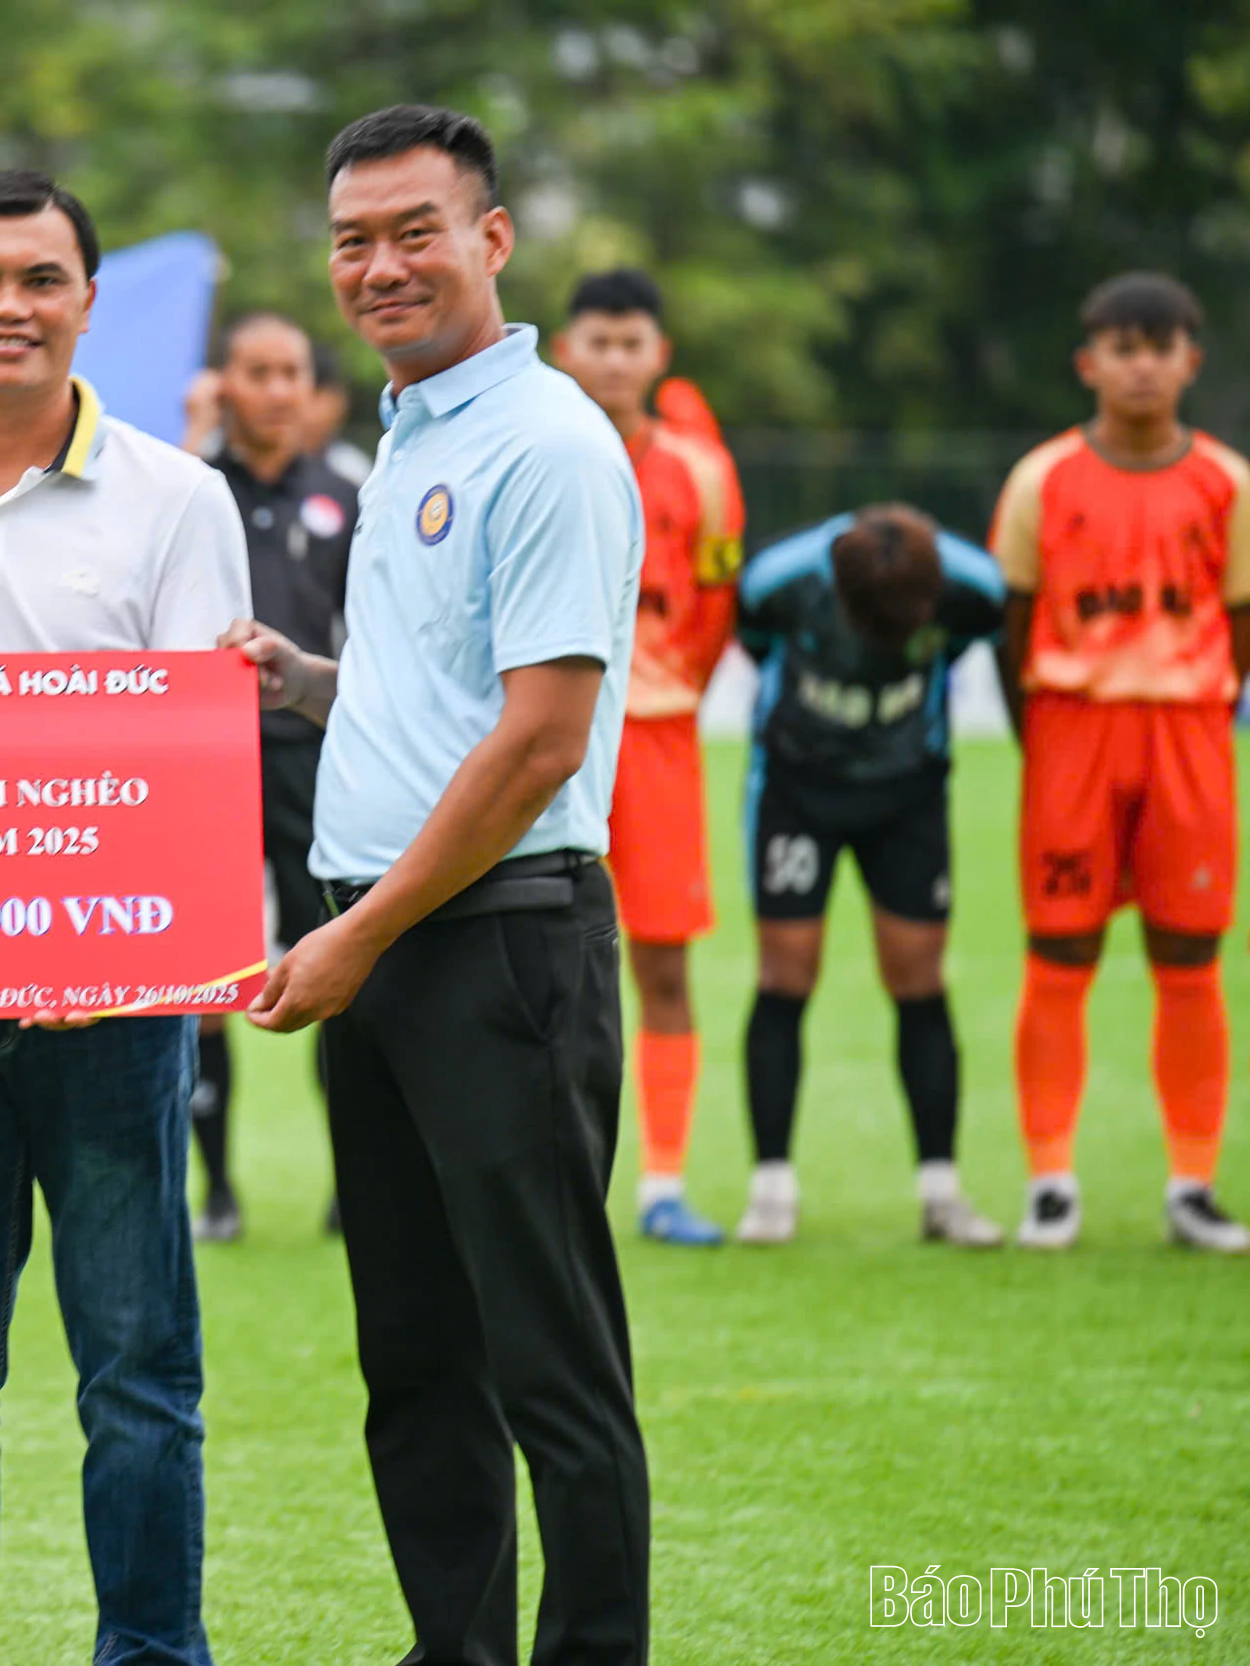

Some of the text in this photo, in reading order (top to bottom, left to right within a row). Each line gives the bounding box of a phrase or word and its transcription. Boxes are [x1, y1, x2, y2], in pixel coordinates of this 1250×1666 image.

[19, 665, 98, 696] HOÀI
[105, 664, 169, 696] ĐỨC
[16, 770, 149, 807] NGHÈO
[26, 826, 100, 856] 2025
[61, 895, 174, 935] VNĐ
[61, 982, 131, 1007] NGÀY
[134, 983, 240, 1007] 26/10/2025
